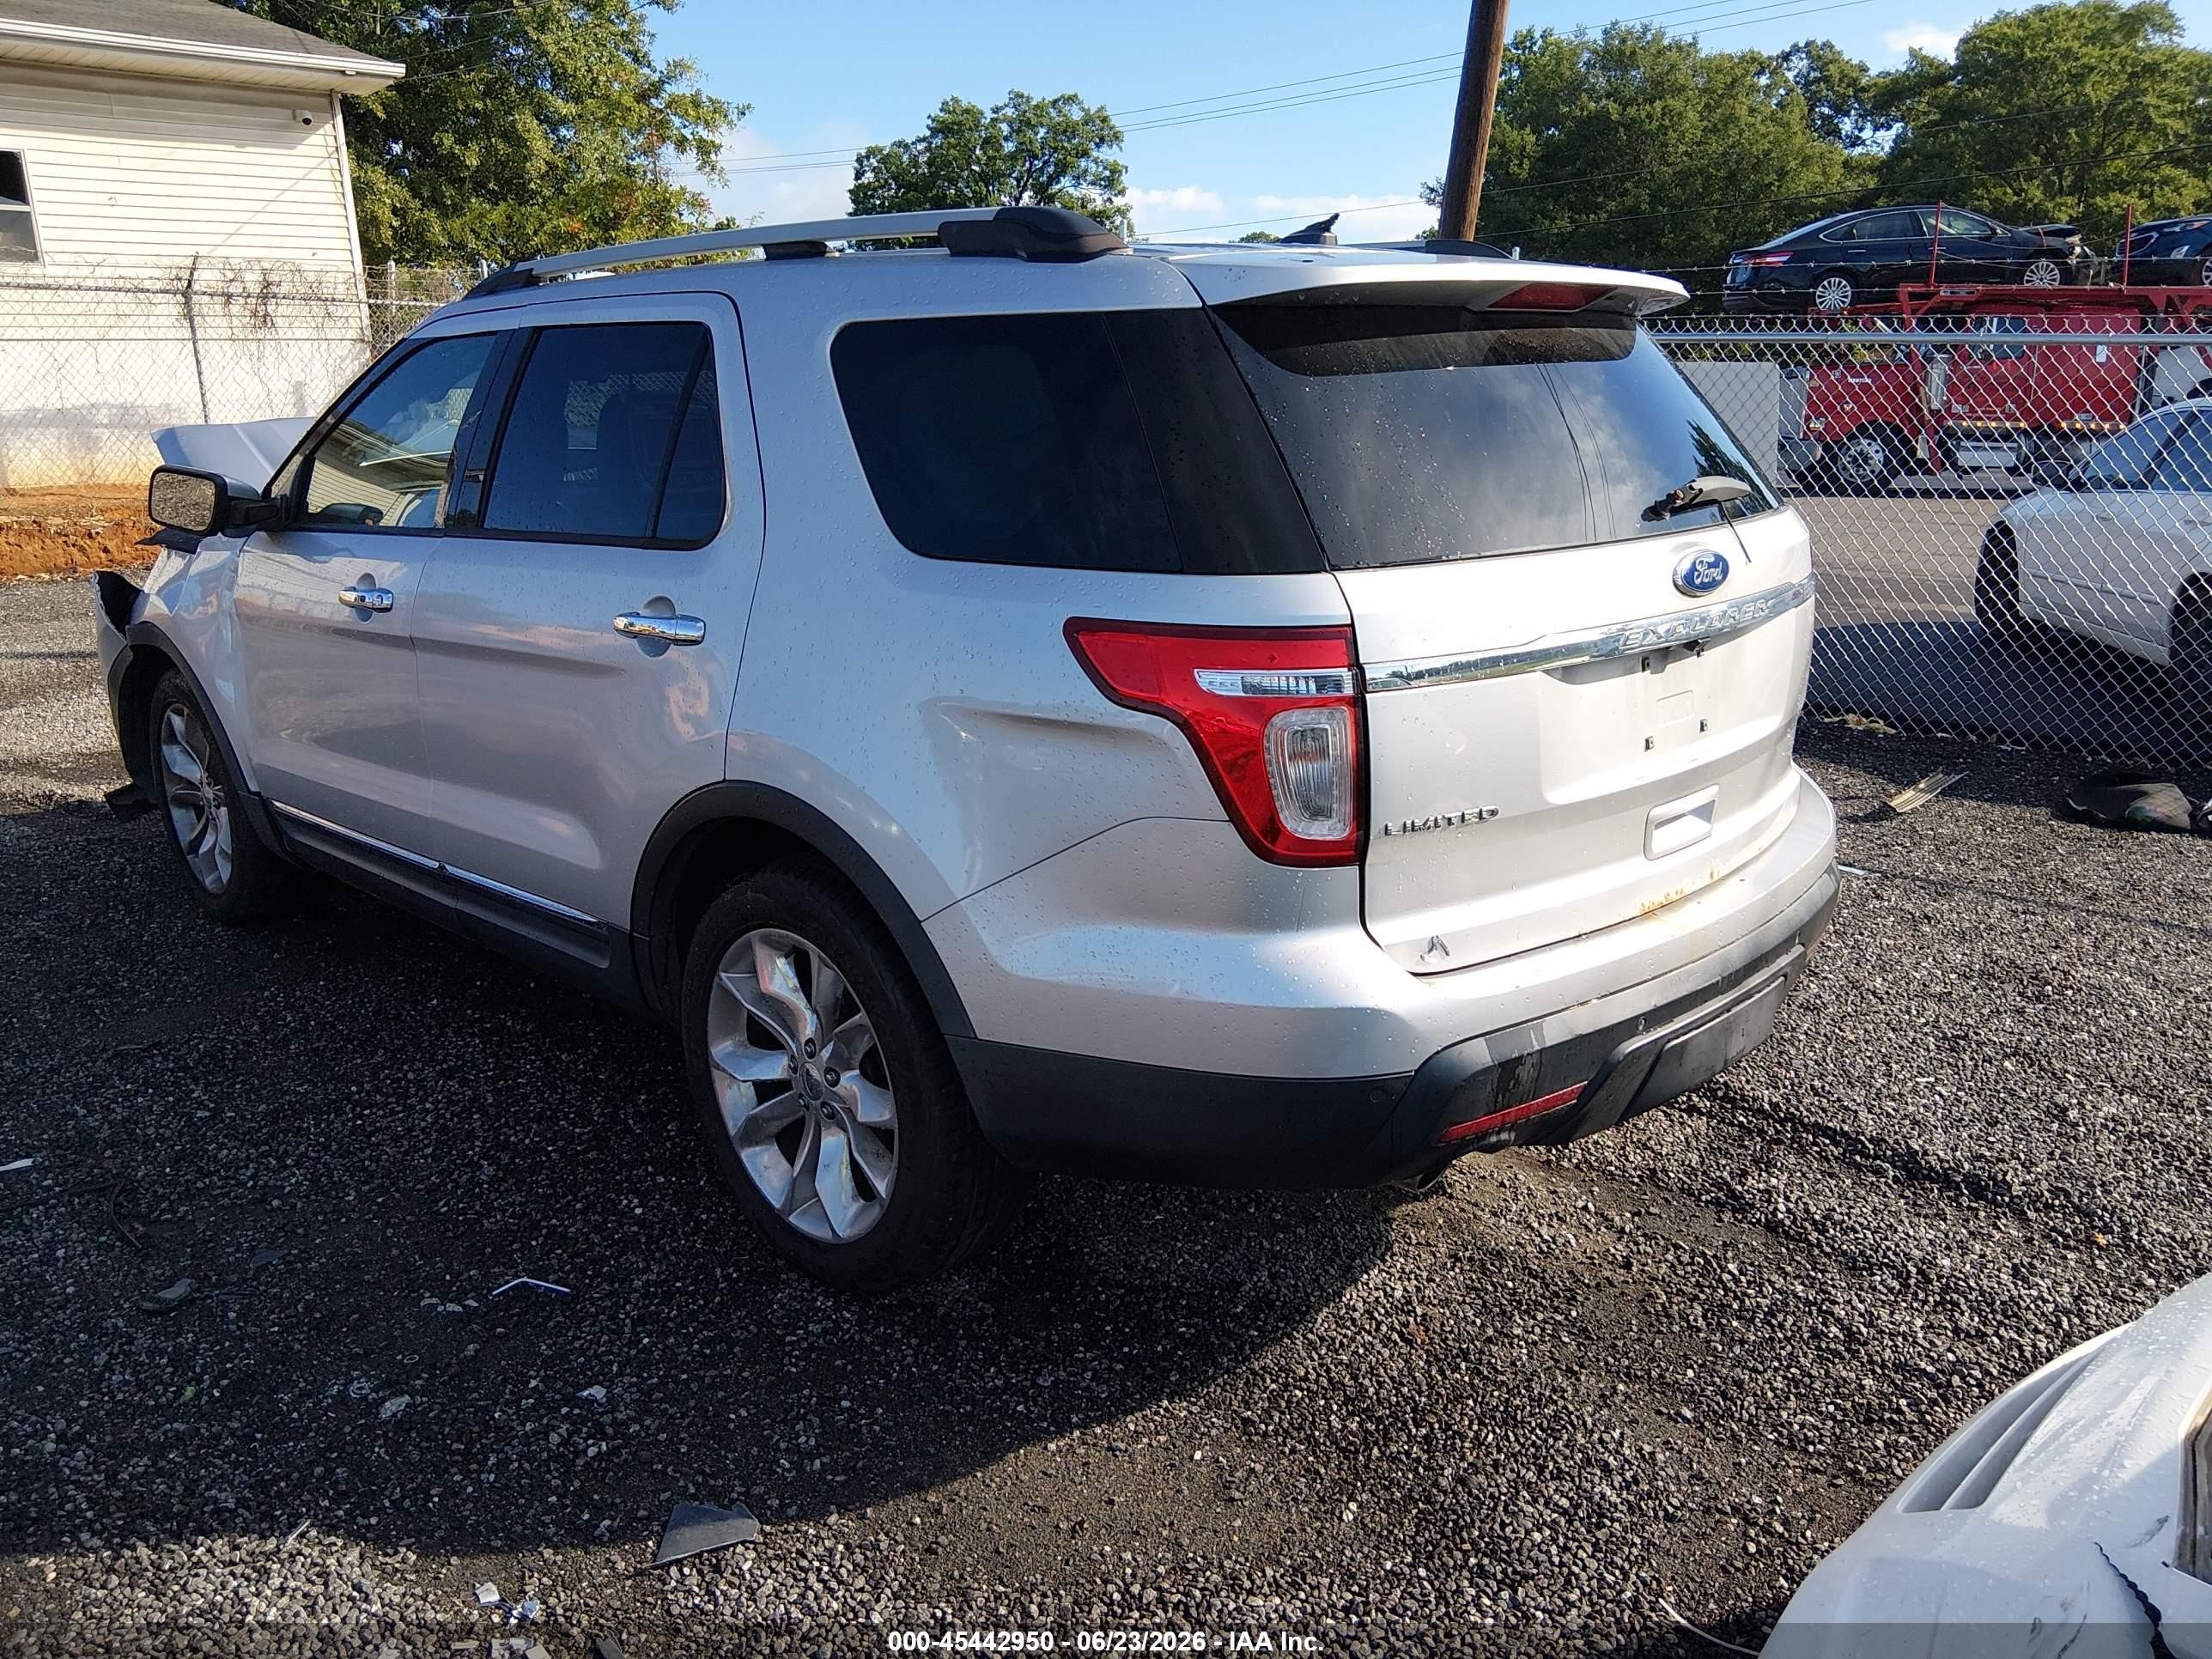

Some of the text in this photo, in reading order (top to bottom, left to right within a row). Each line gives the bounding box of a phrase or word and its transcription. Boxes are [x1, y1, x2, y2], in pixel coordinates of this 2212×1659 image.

[1693, 552, 1723, 585] Ford
[1619, 599, 1774, 650] EXPLORER
[1384, 805, 1499, 836] LIMITED
